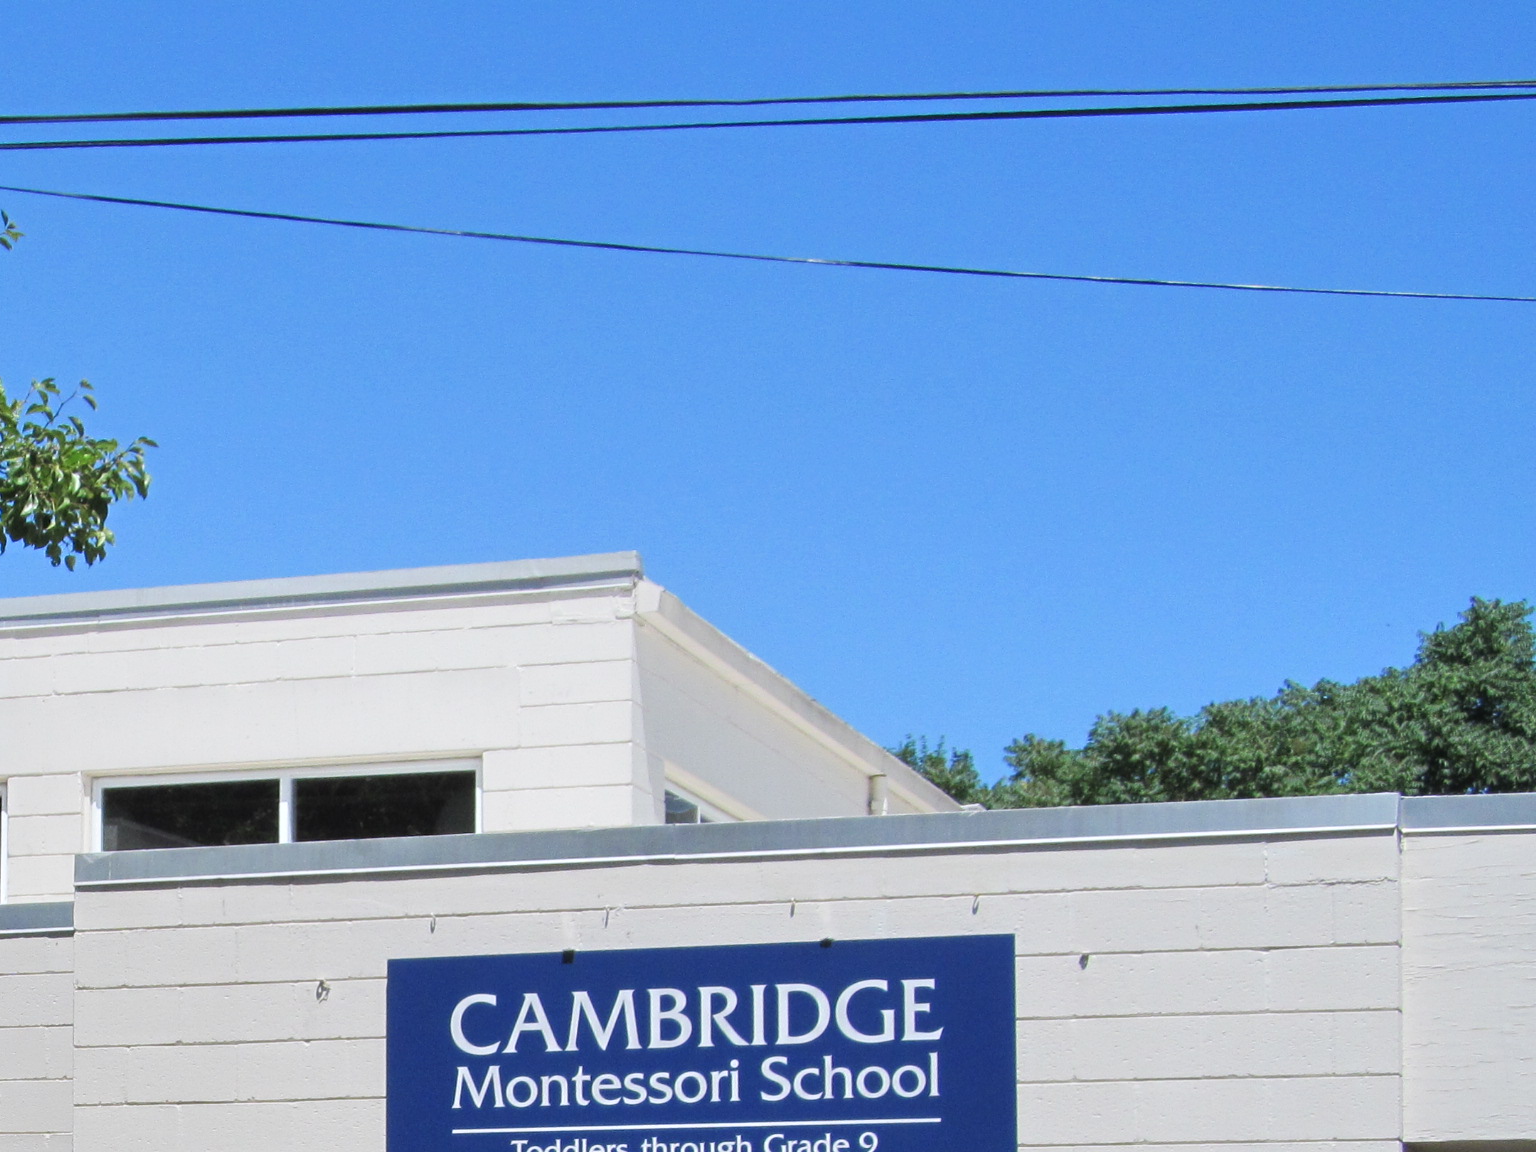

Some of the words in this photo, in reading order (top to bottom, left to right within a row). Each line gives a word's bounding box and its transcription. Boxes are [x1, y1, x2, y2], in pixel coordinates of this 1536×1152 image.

[450, 978, 944, 1056] CAMBRIDGE
[451, 1058, 741, 1109] Montessori
[760, 1051, 940, 1102] School
